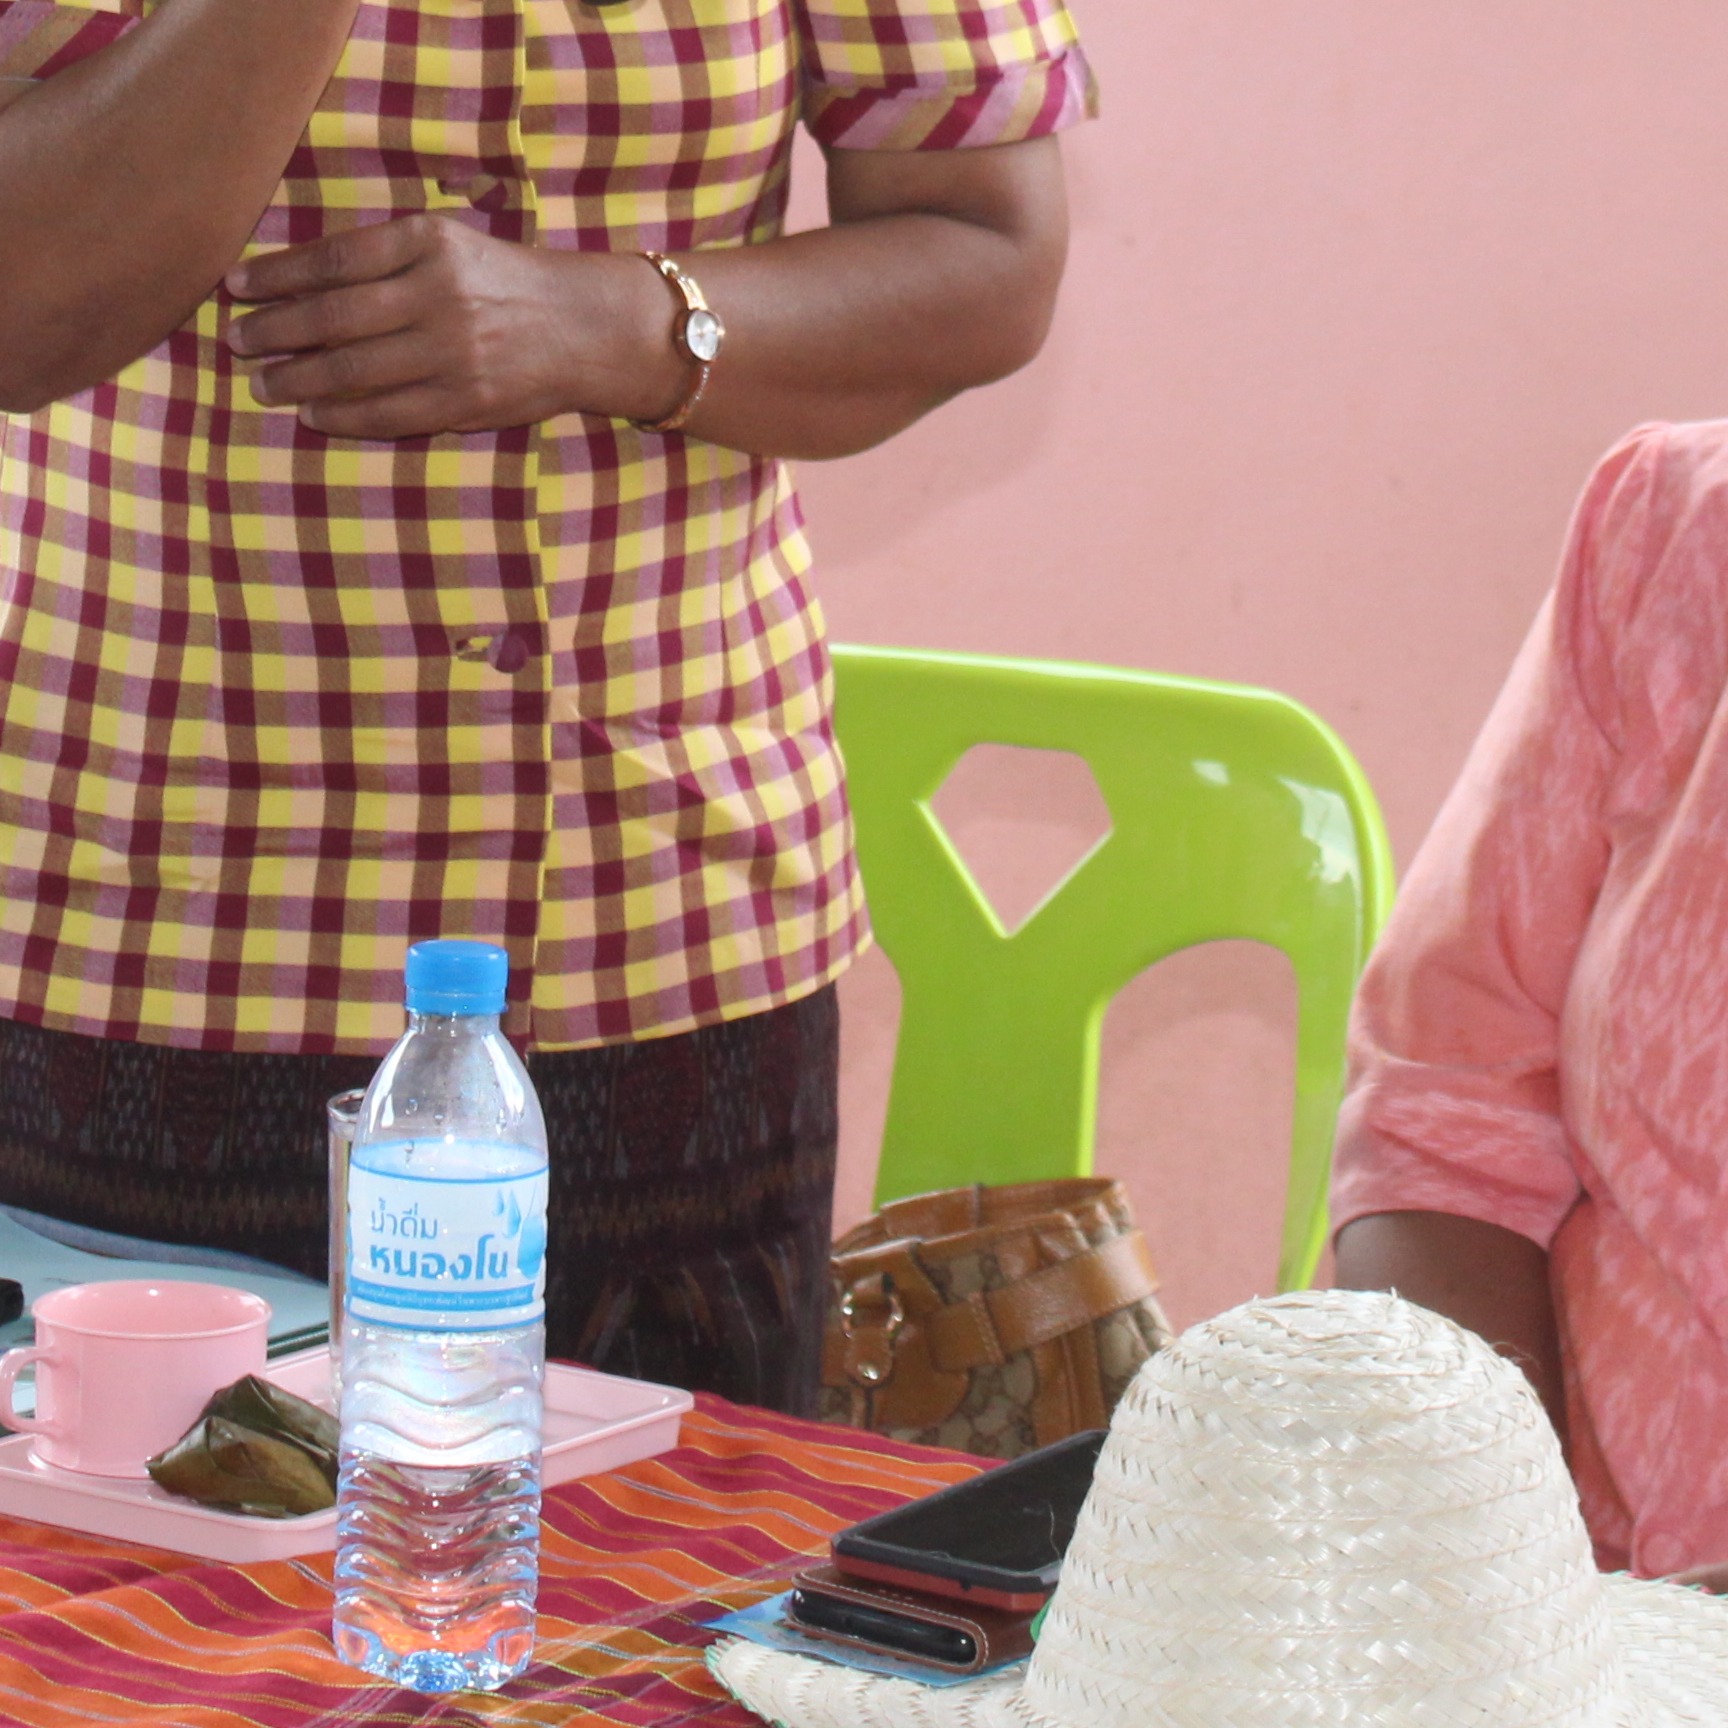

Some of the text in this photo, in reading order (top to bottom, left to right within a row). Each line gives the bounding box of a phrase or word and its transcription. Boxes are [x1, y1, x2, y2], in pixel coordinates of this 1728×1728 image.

[371, 1197, 438, 1240] น้ำดื่ม
[370, 1233, 509, 1281] หนองโน
